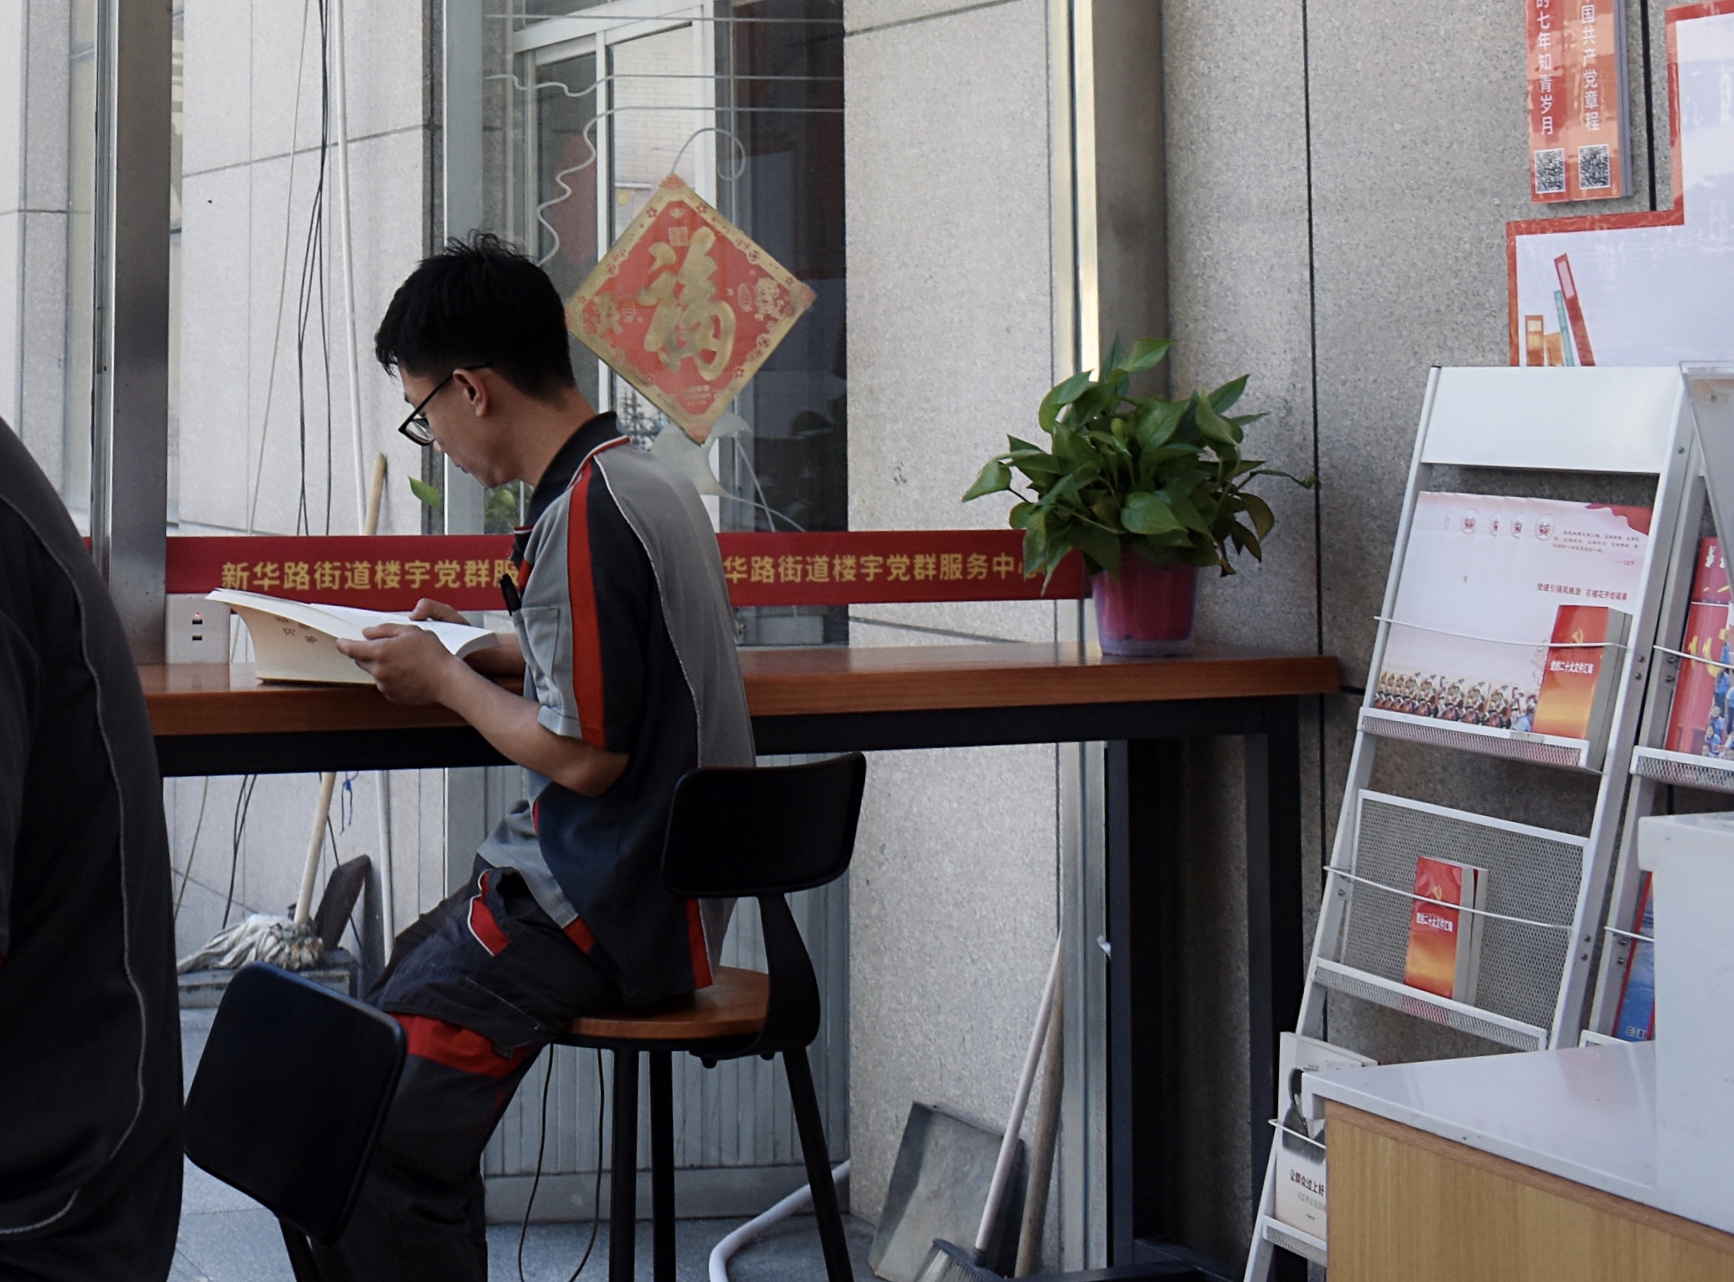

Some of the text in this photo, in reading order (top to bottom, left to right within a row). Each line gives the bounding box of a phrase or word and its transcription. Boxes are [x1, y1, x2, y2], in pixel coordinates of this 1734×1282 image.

[637, 225, 737, 381] 福
[221, 559, 520, 591] 新华路街道楼宇党群服
